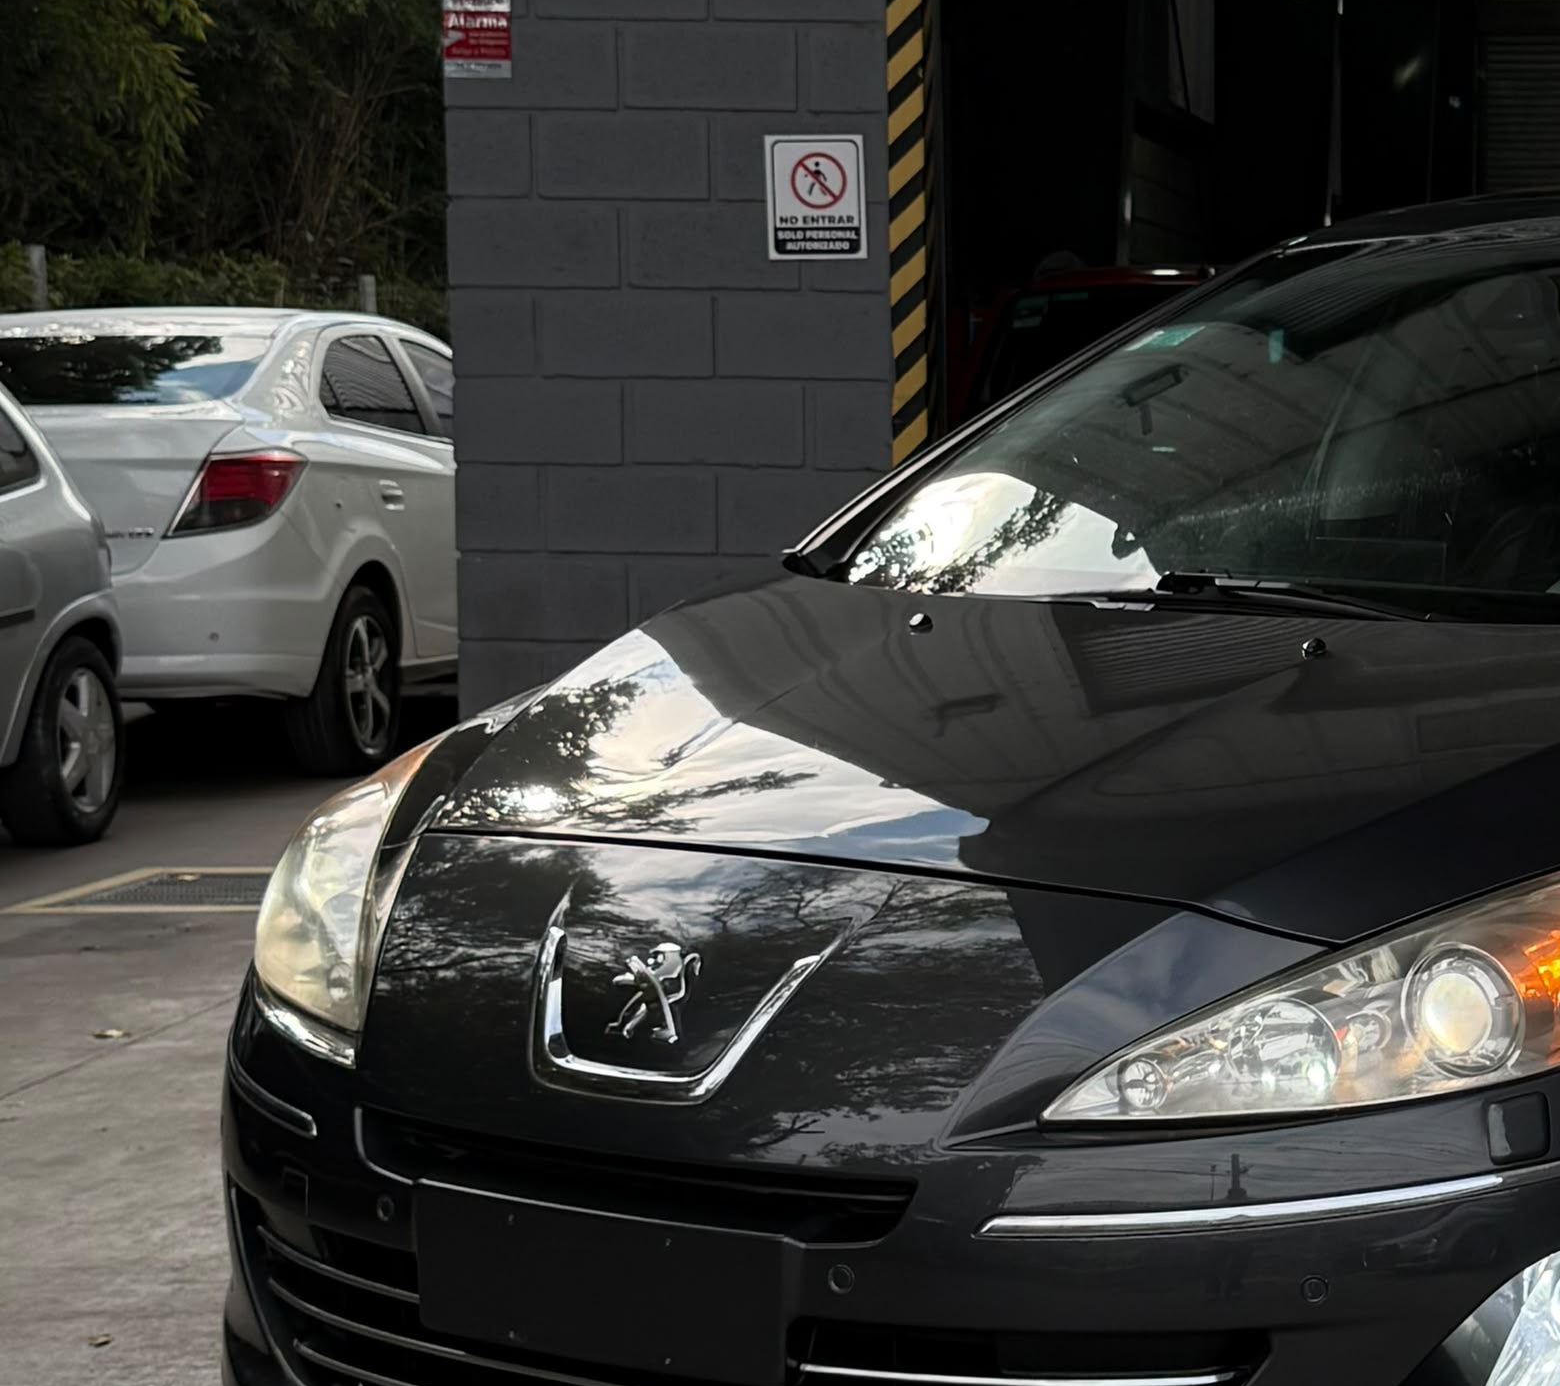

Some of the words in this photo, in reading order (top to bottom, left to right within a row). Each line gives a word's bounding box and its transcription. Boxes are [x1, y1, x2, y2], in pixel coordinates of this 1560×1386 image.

[447, 13, 508, 28] Alarma
[779, 215, 799, 225] NO
[802, 215, 855, 225] ENTRAR
[777, 230, 804, 240] SOLO
[805, 229, 858, 240] PERSONAL
[786, 241, 850, 250] AUTORIZADO
